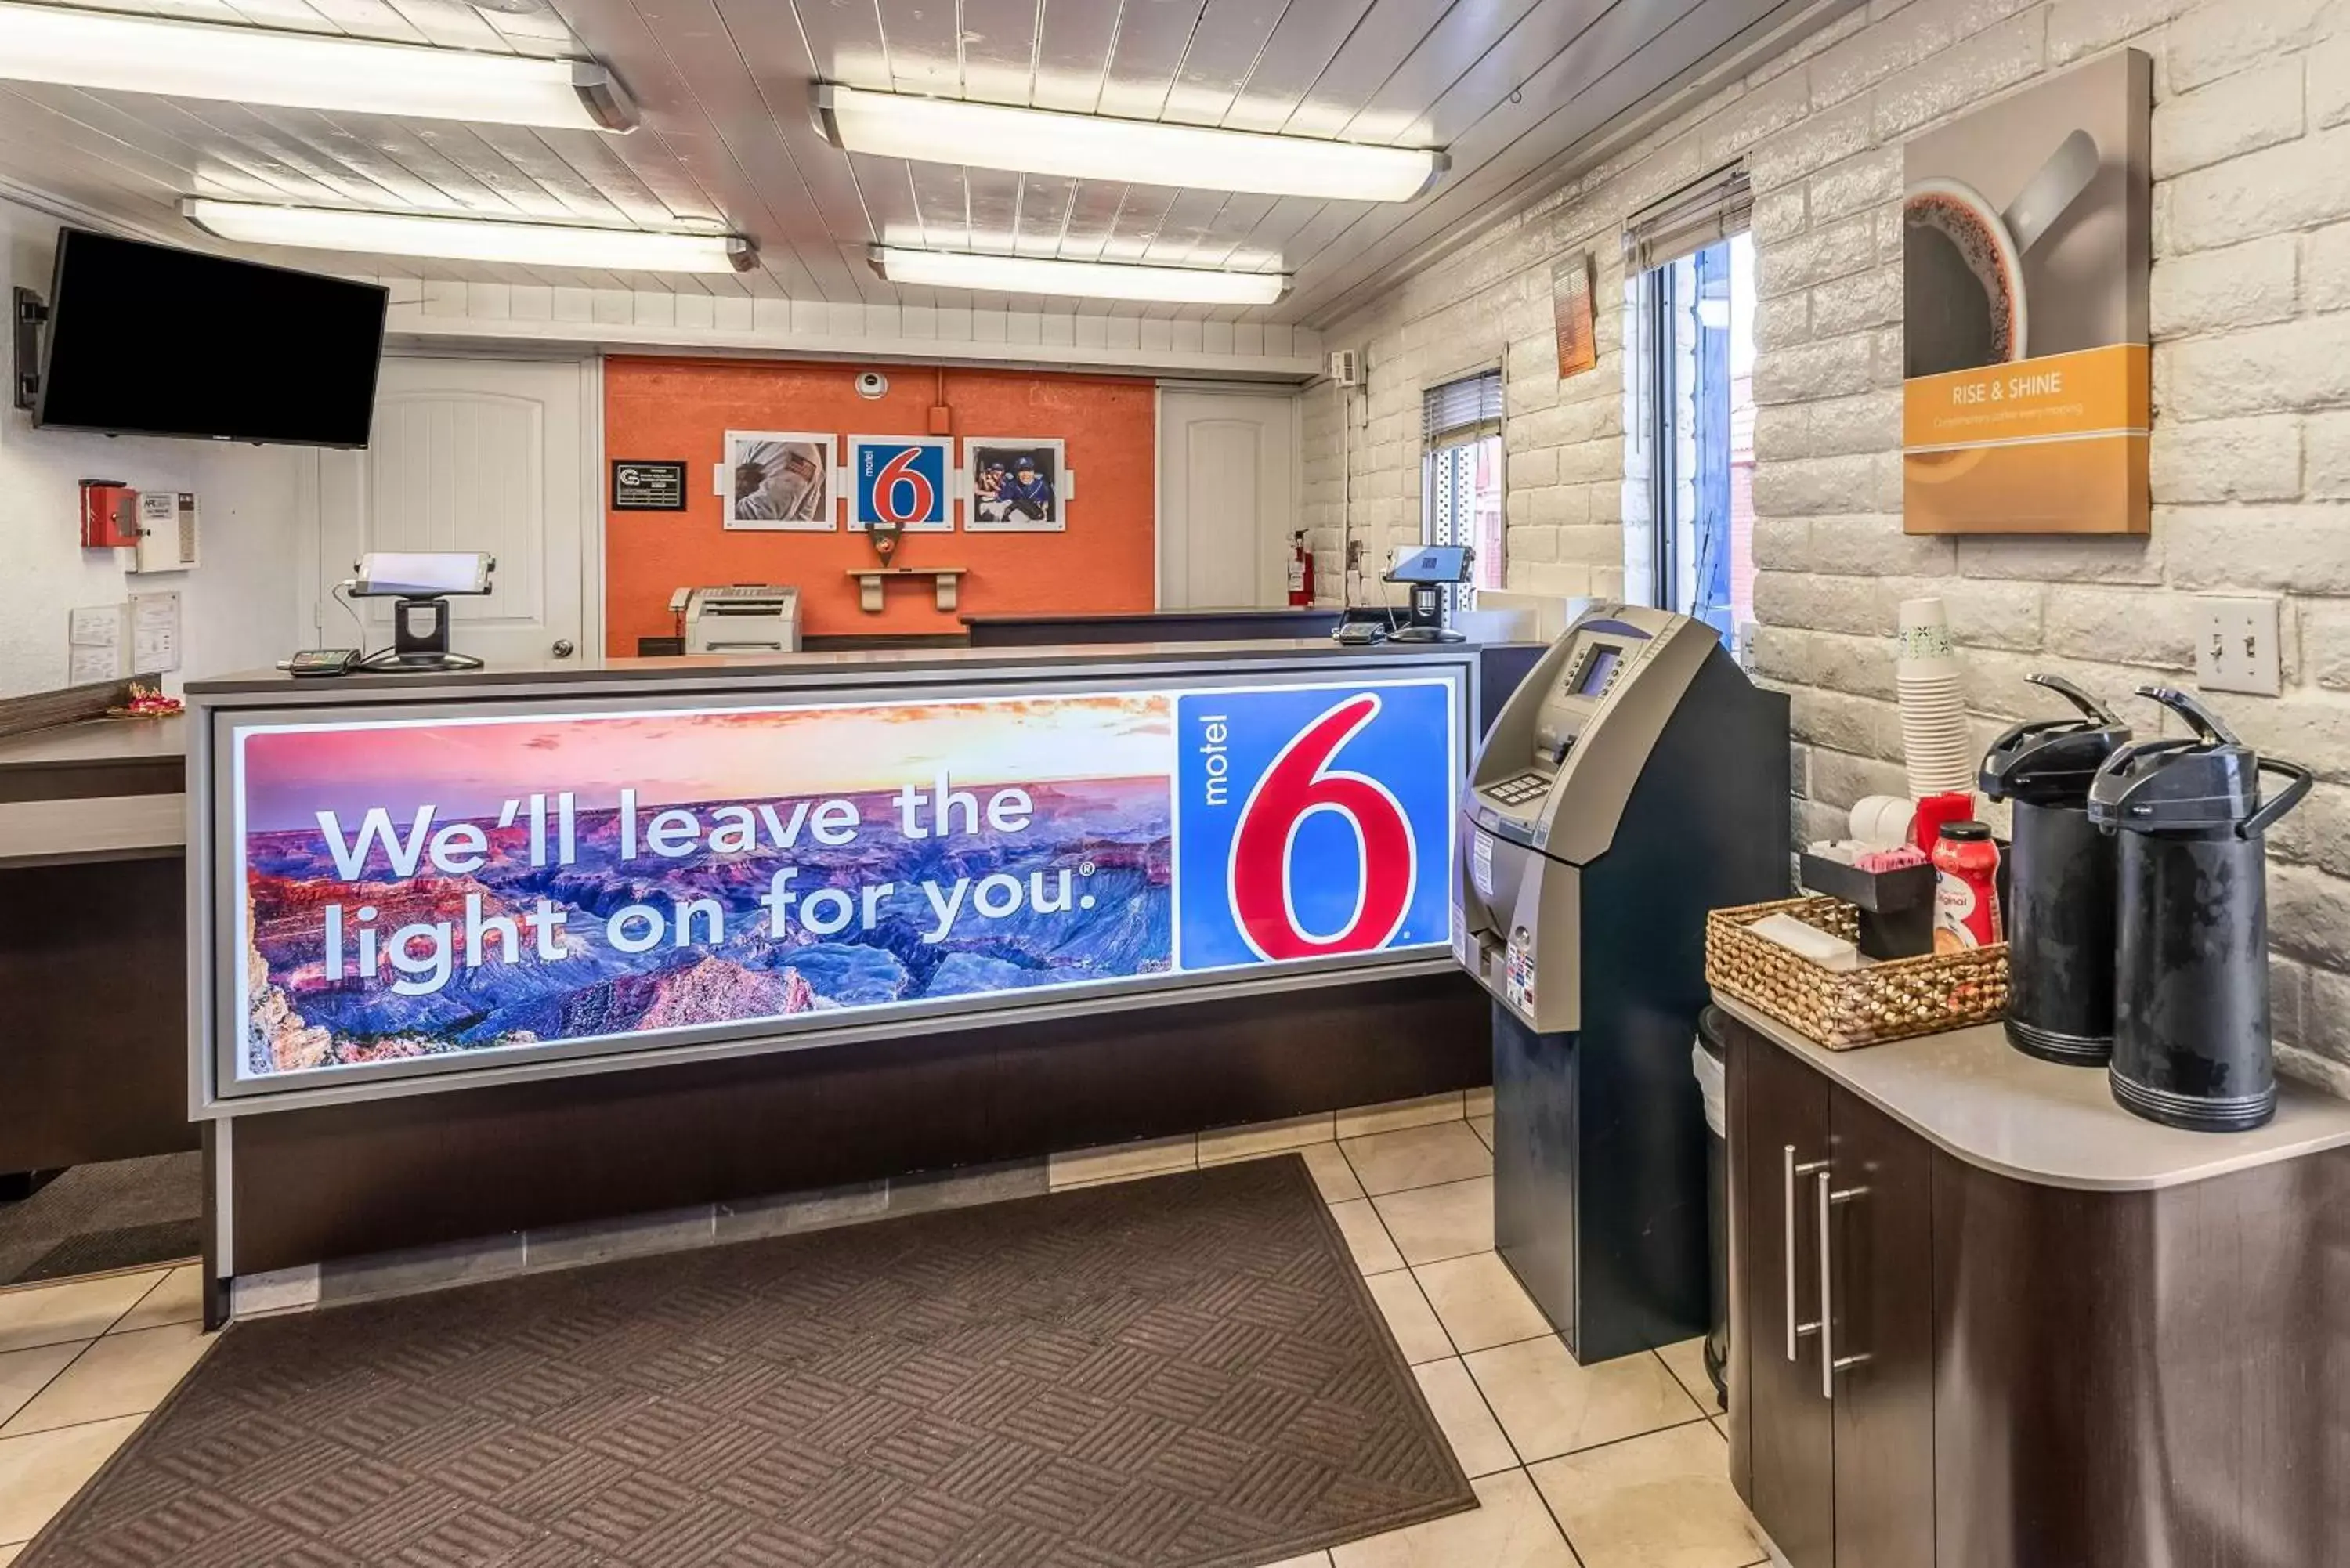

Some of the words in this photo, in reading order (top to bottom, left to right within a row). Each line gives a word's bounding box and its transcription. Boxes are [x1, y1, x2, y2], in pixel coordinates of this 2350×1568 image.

[1952, 383, 1987, 405] RISE
[1990, 379, 2005, 402] &
[2008, 371, 2063, 399] SHINE
[864, 450, 873, 477] motel
[873, 447, 934, 523] 6
[1198, 714, 1228, 807] motel
[315, 790, 576, 881] We'll
[620, 788, 861, 861] leave
[892, 770, 1034, 840] the
[1227, 692, 1418, 963] 6
[324, 894, 568, 996] light
[606, 894, 724, 954] on
[761, 867, 895, 939] for
